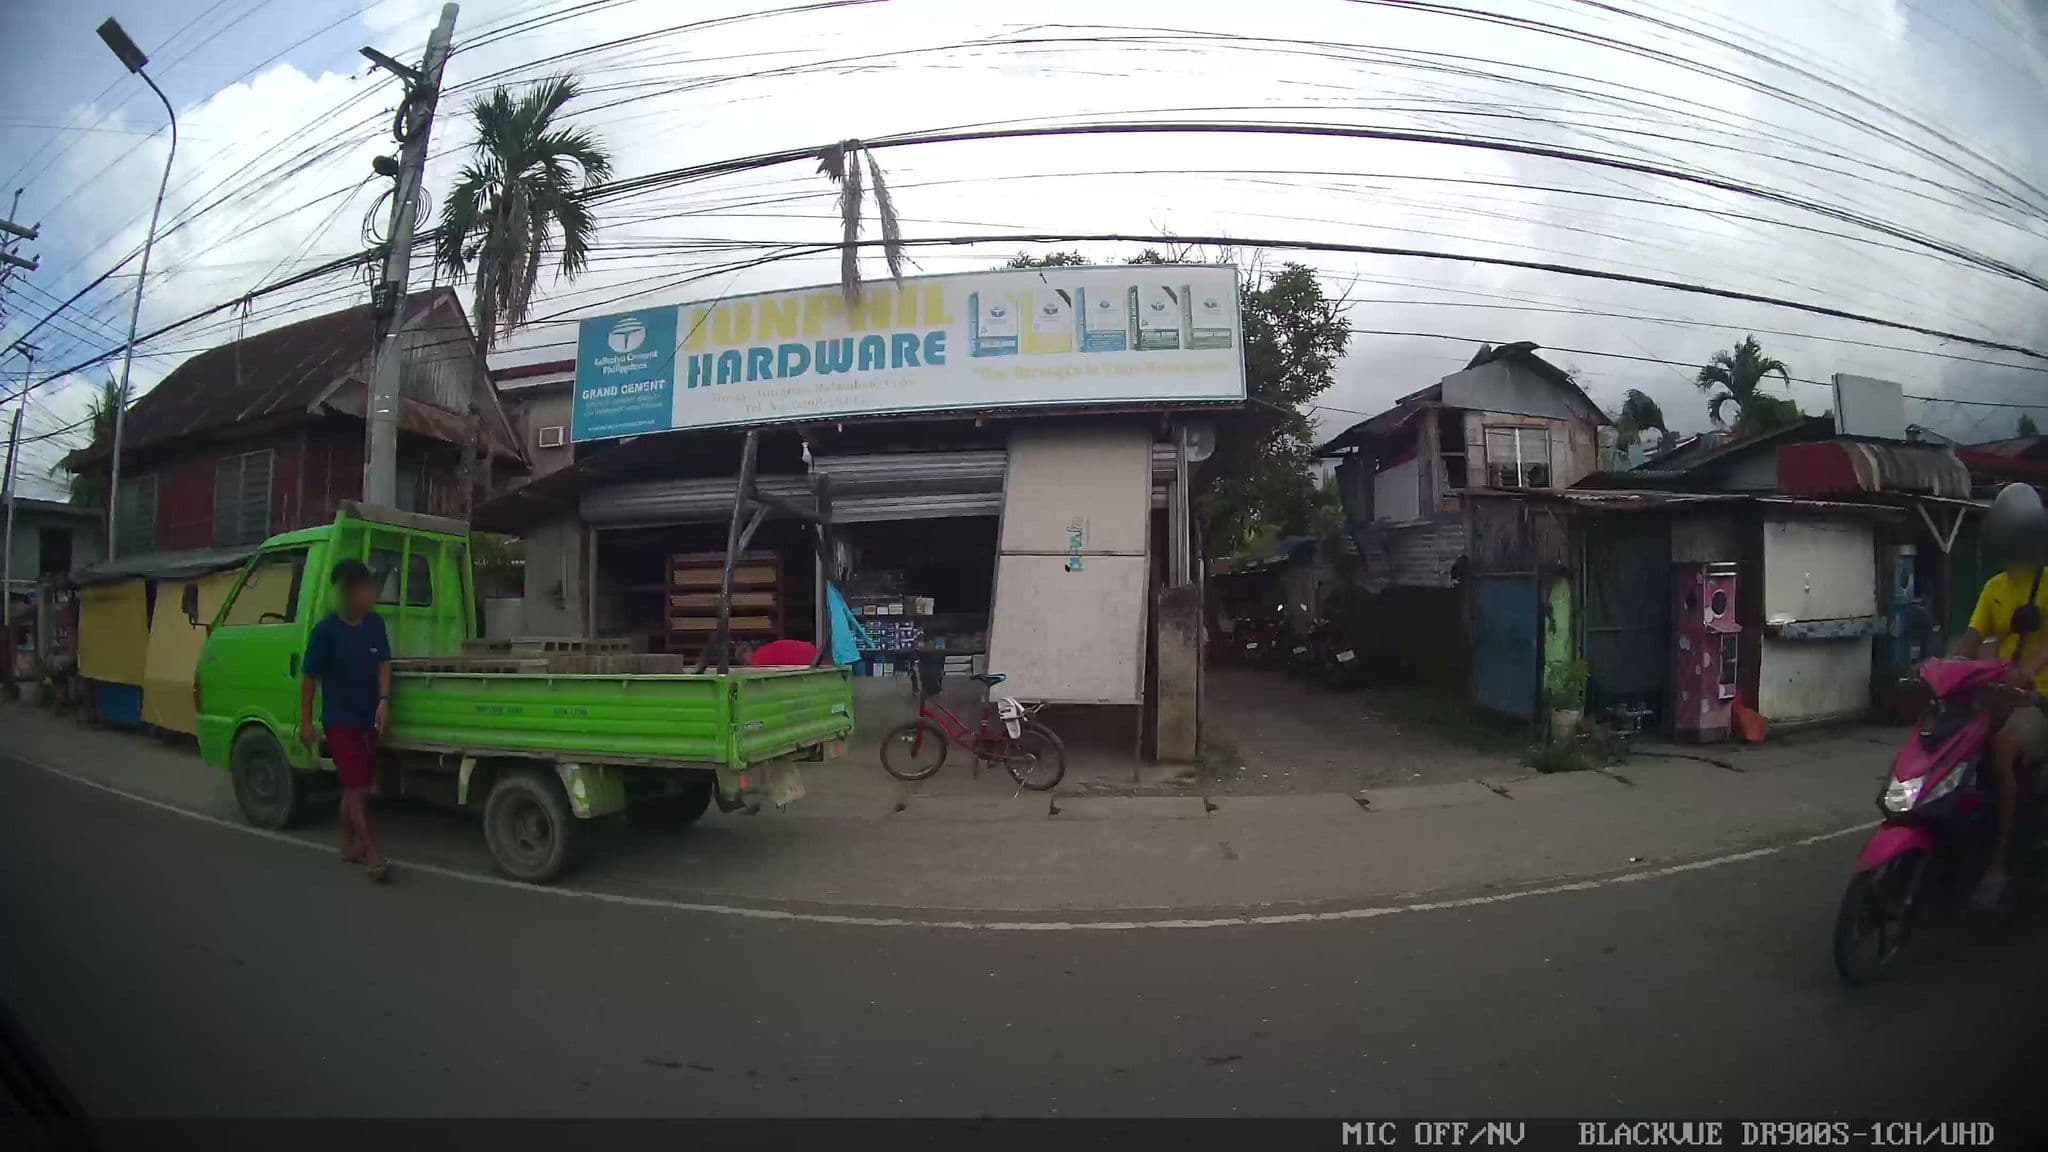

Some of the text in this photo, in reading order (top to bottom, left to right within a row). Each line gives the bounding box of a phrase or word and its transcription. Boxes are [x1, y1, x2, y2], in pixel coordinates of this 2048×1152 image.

[687, 330, 947, 389] HARDWARE
[582, 379, 666, 400] GRAND CEMENT
